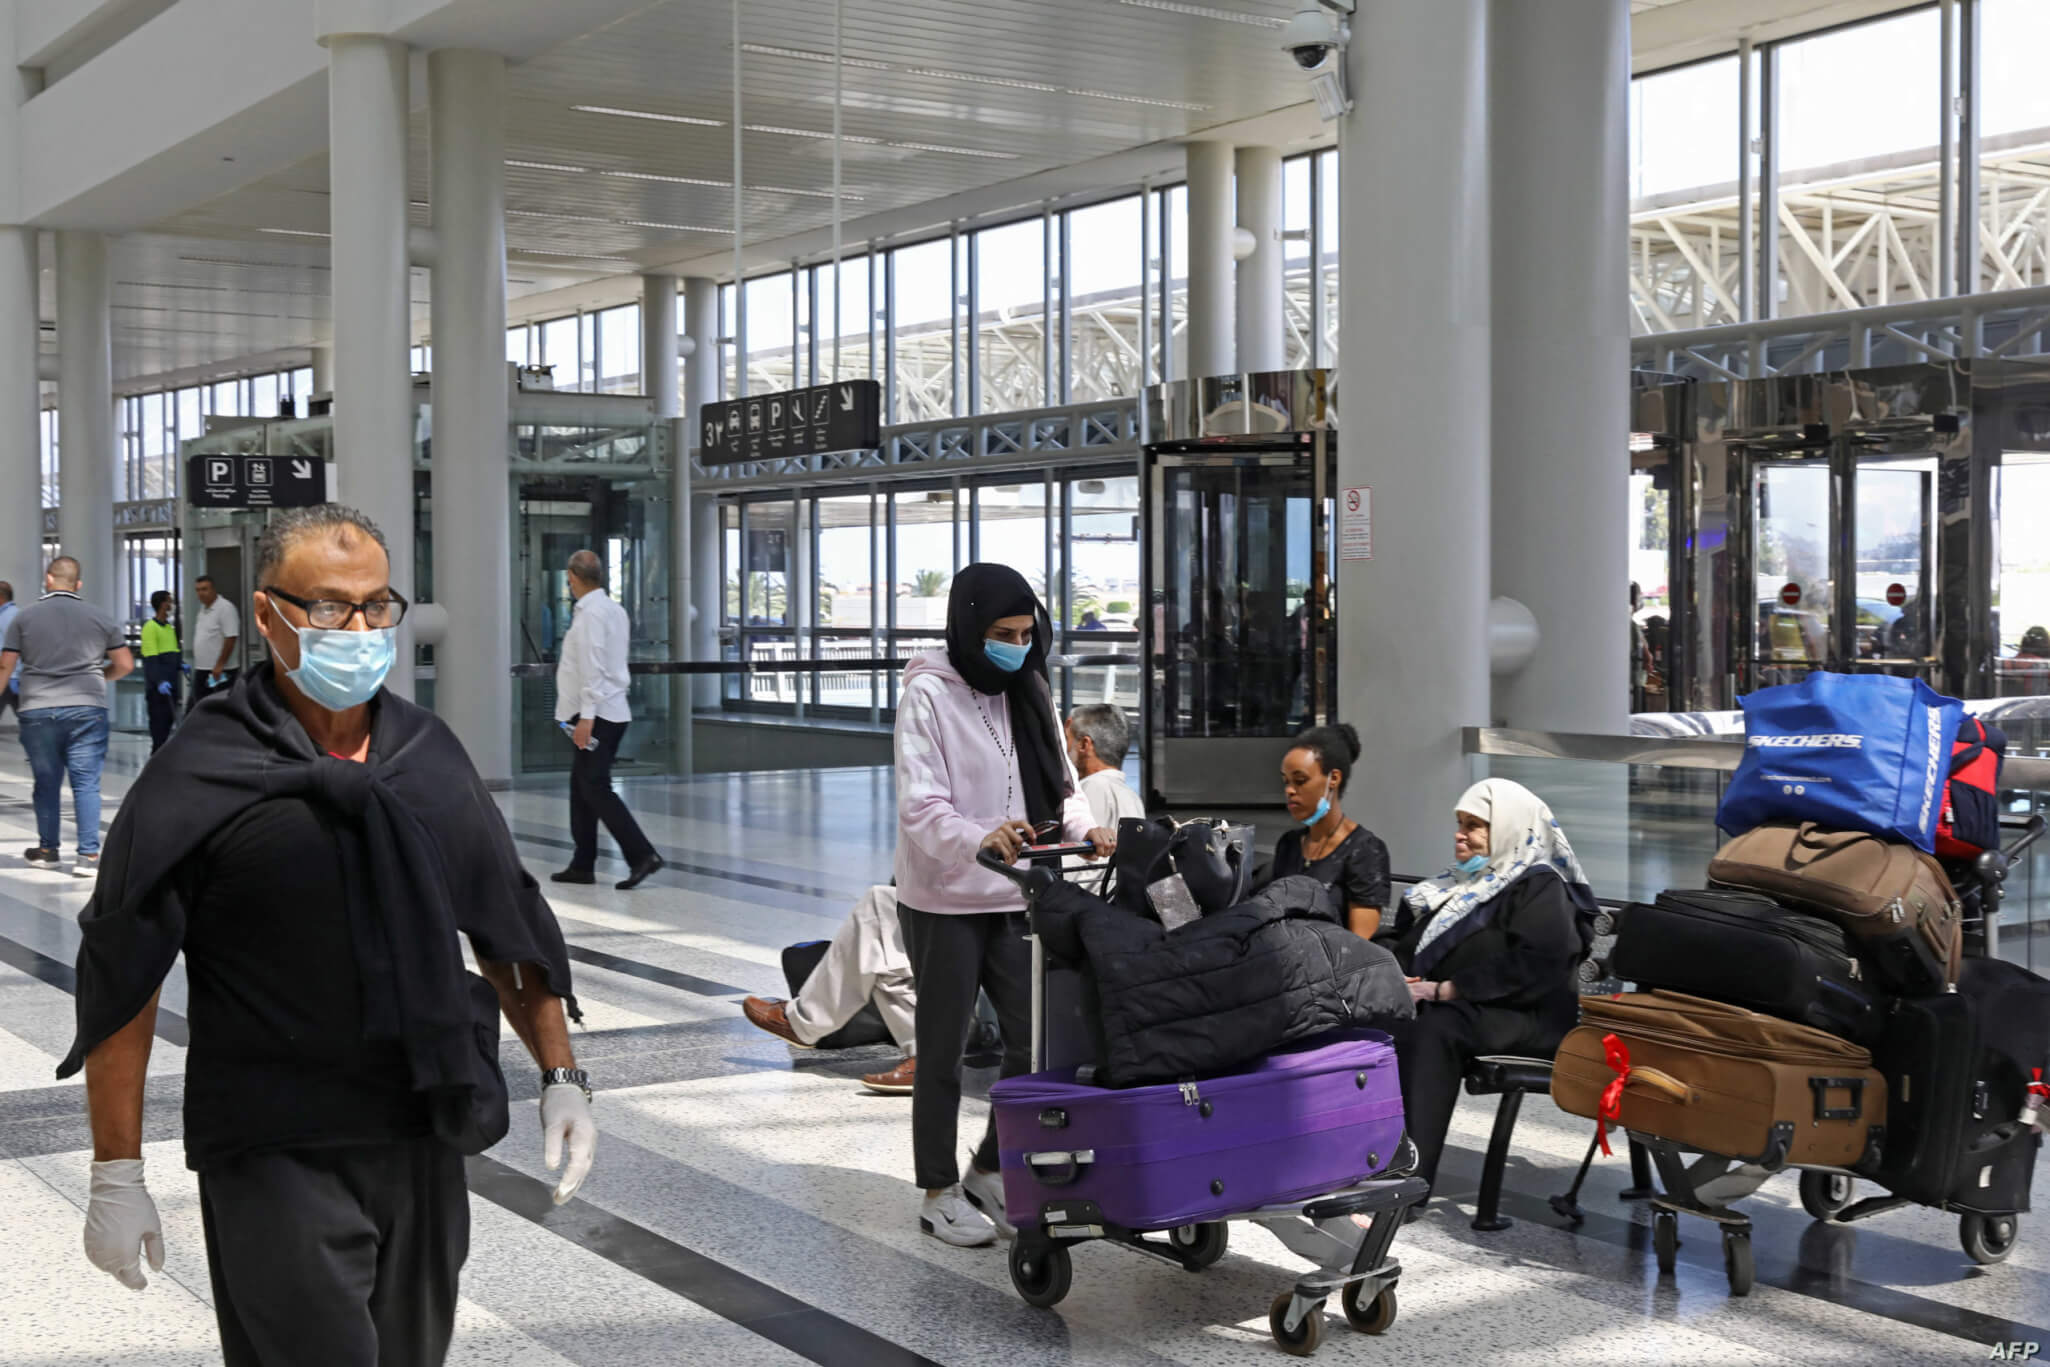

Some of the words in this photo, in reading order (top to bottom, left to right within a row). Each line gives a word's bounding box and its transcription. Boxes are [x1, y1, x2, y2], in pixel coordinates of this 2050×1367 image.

[771, 402, 782, 426] P
[211, 462, 228, 481] P
[1749, 734, 1864, 748] SKECHERS
[1918, 705, 1941, 834] SKECHERS
